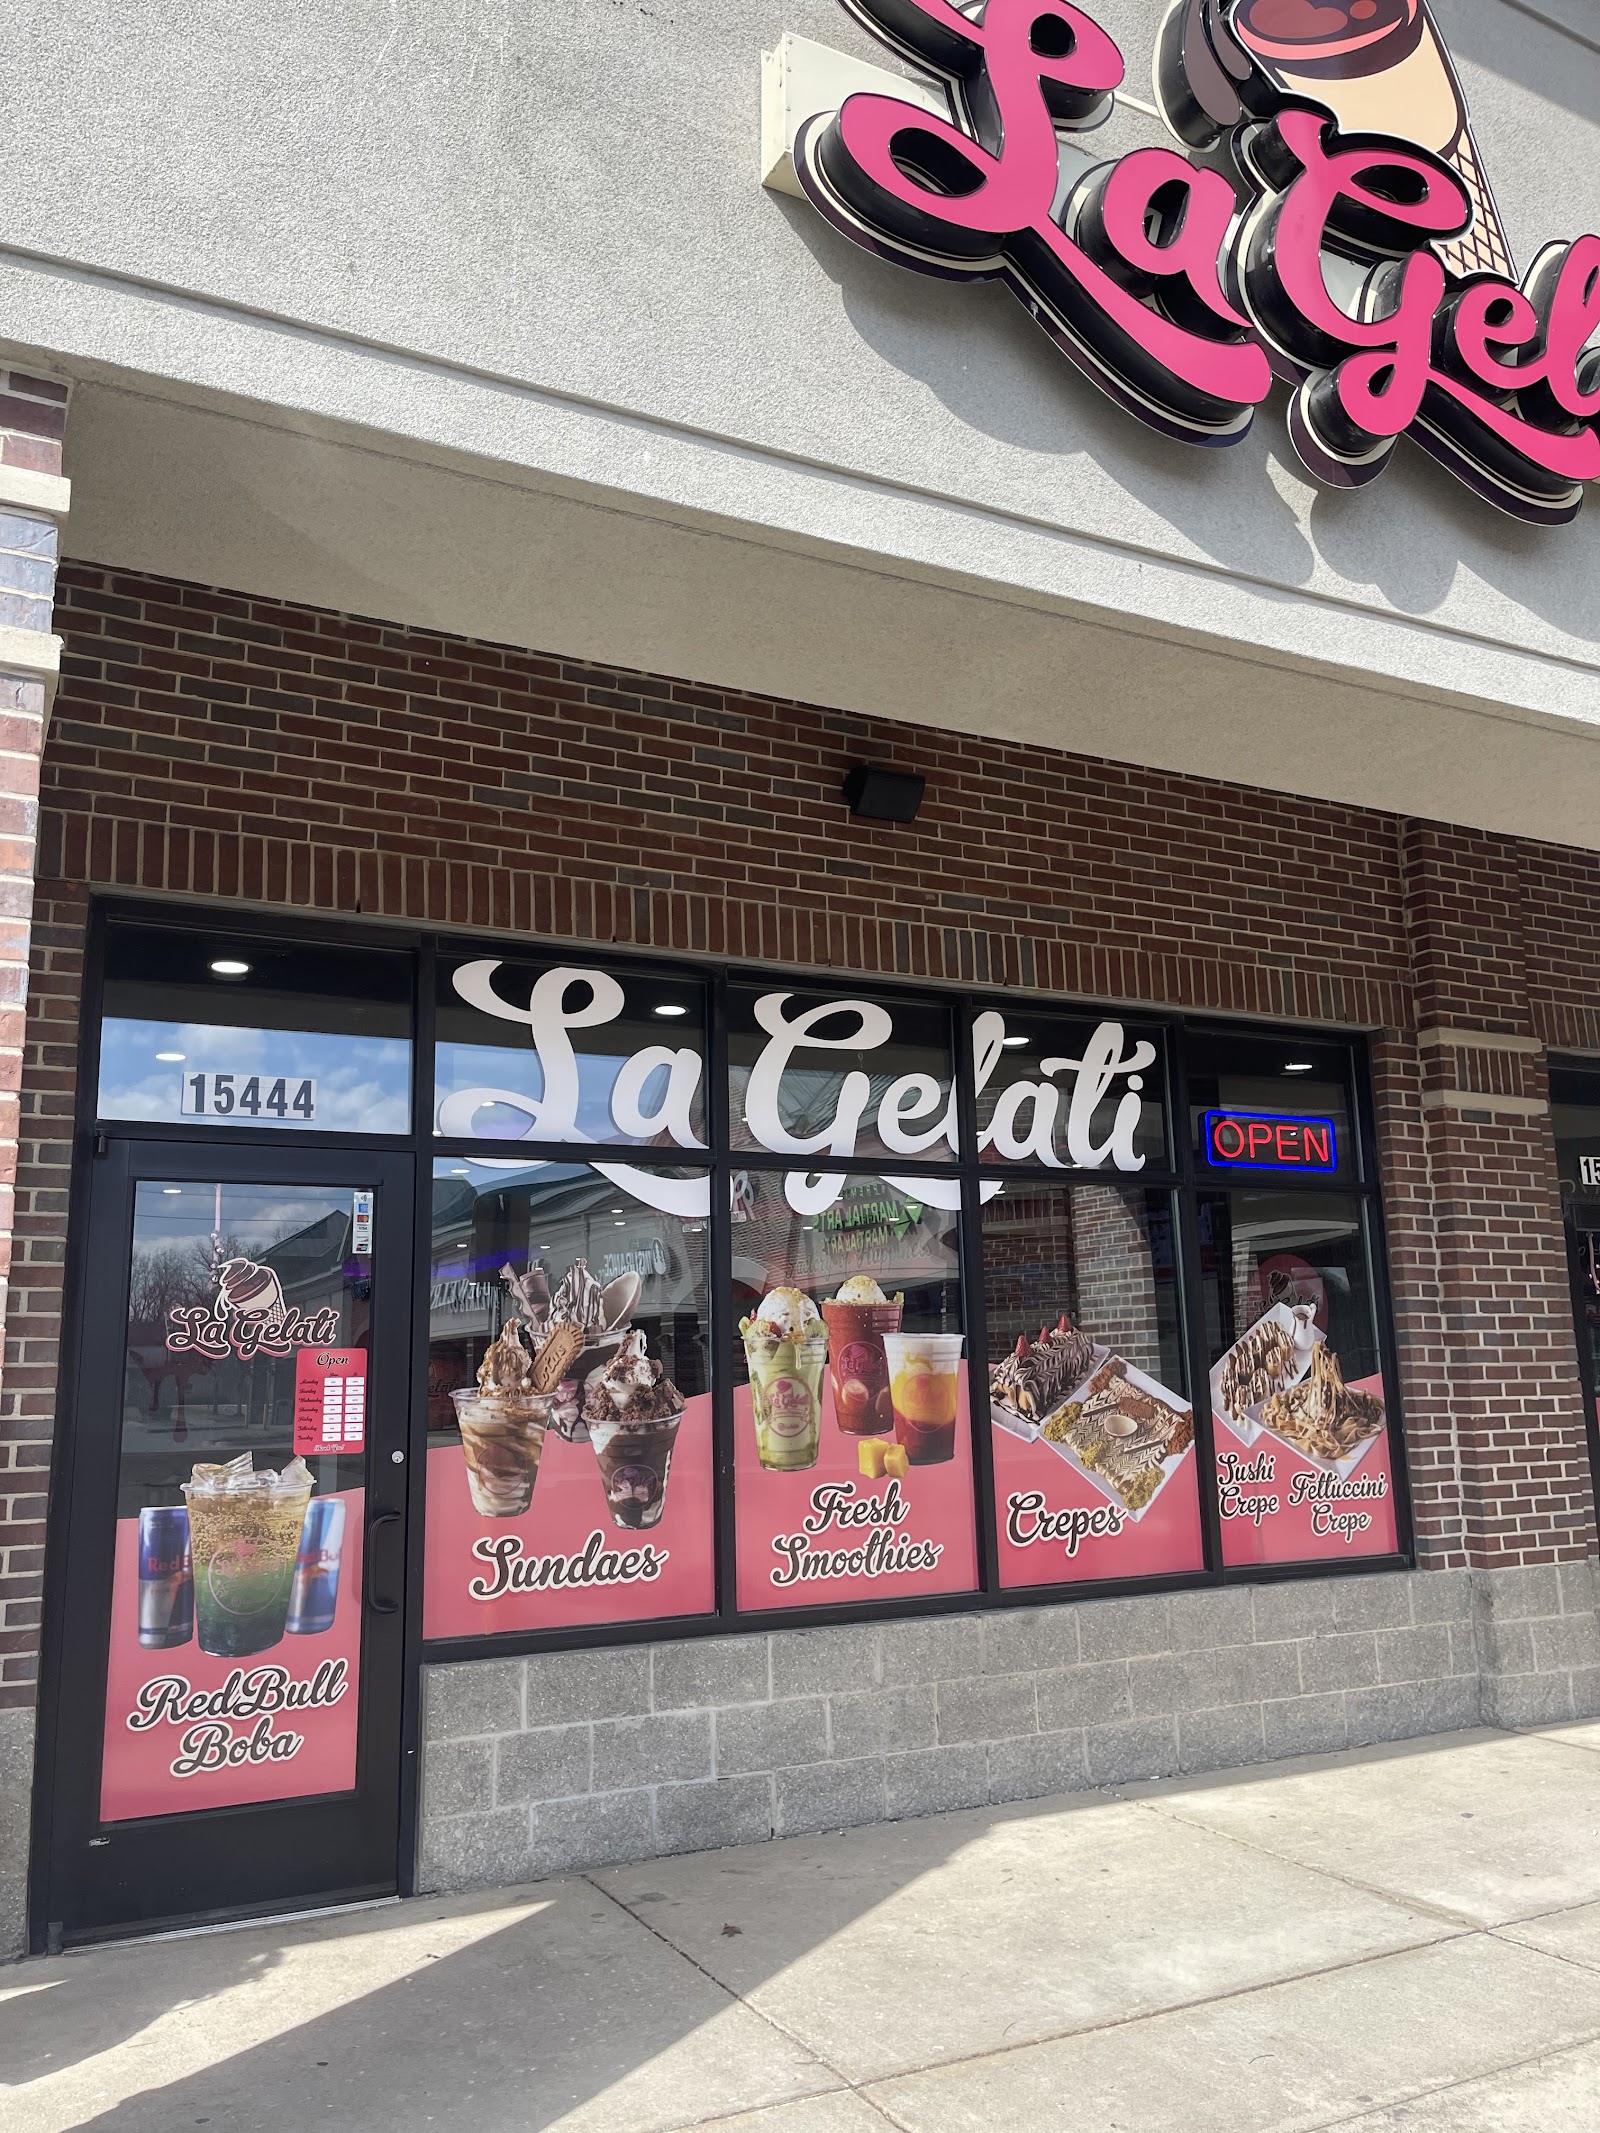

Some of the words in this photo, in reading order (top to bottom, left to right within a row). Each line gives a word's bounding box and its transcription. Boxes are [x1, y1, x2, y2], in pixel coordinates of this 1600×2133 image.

[835, 0, 1273, 405] La
[189, 1072, 314, 1119] 15444
[439, 958, 734, 1218] La
[743, 992, 1157, 1216] Gelati
[1213, 1120, 1330, 1163] OPEN
[166, 1307, 231, 1358] La
[231, 1305, 341, 1361] Gelati
[316, 1352, 349, 1370] Open
[1217, 1451, 1275, 1487] Sushi
[1288, 1471, 1388, 1508] Fettuccini
[803, 1479, 911, 1535] Fresh
[1006, 1490, 1127, 1558] Crepes
[1218, 1485, 1281, 1528] Crepe
[1311, 1504, 1373, 1543] Crepe
[148, 1555, 180, 1573] Red
[469, 1529, 669, 1601] Sundaes
[769, 1527, 943, 1588] Smoothies
[126, 1657, 350, 1732] RedBull
[169, 1715, 305, 1779] Boba
